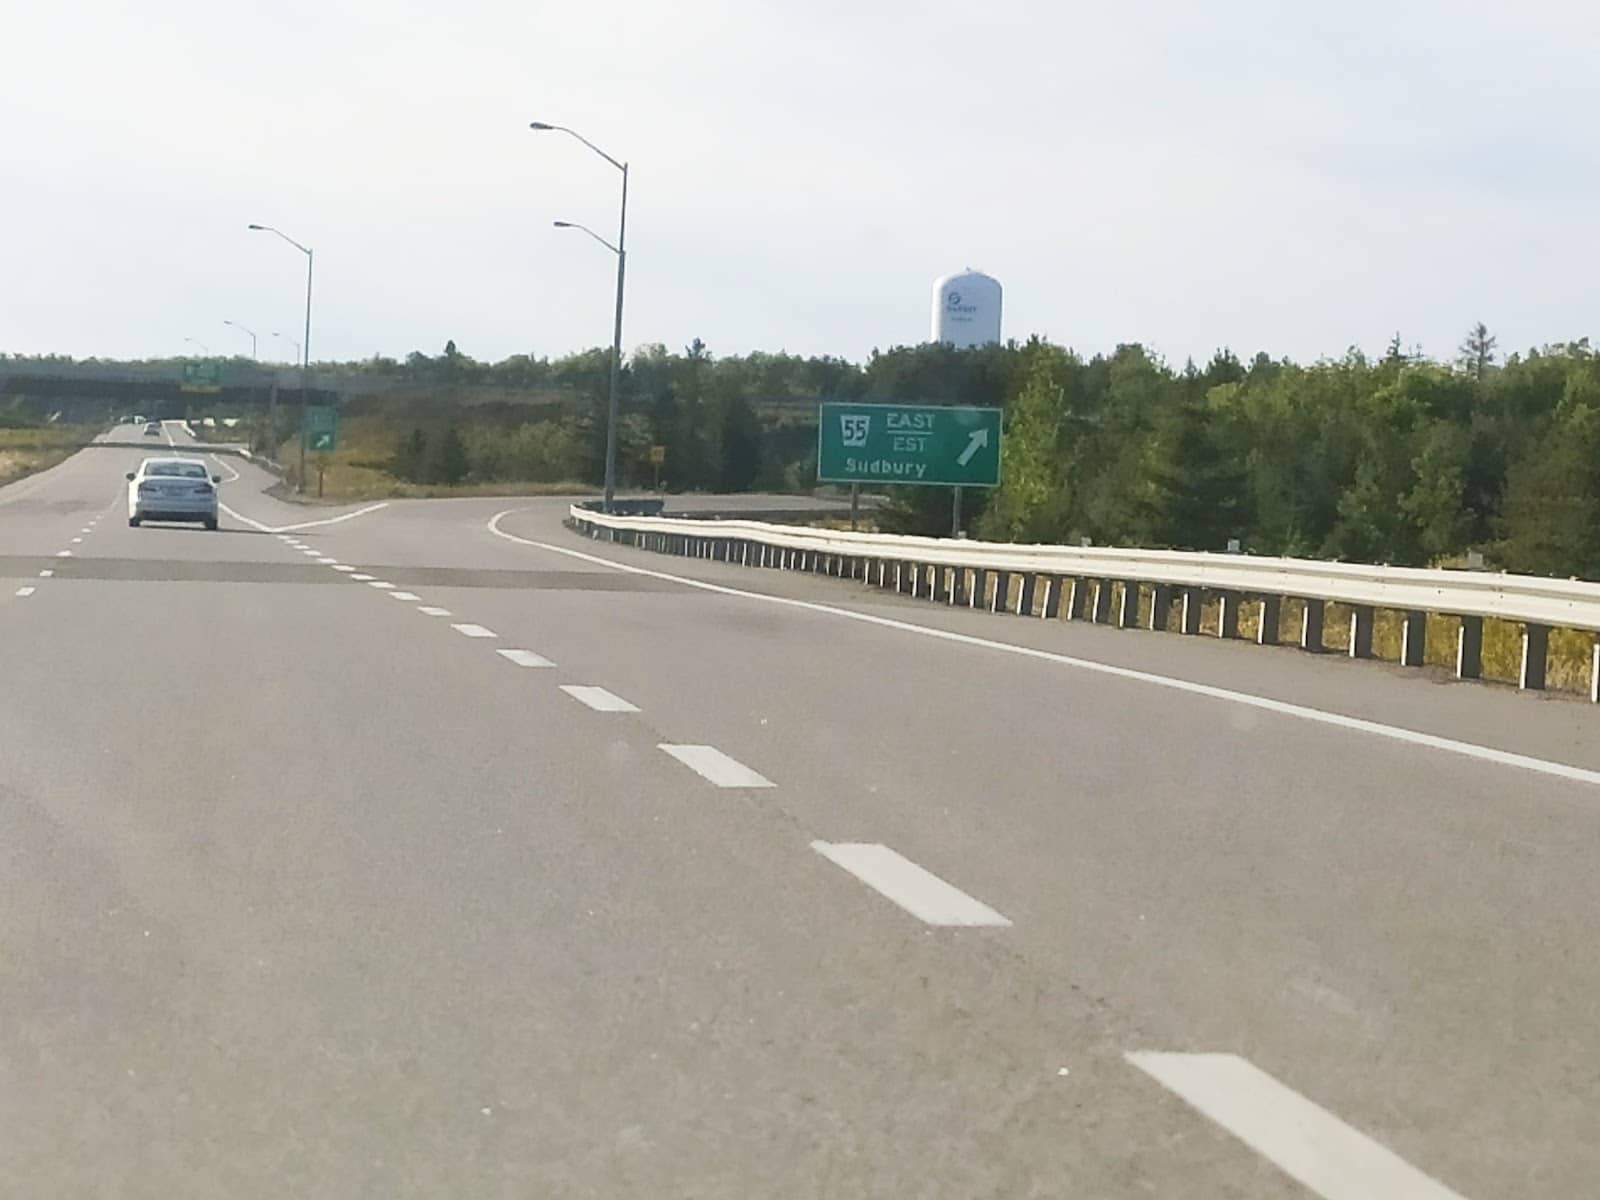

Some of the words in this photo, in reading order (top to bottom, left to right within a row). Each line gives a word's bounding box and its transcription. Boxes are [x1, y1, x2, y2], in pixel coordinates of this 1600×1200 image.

[844, 419, 866, 441] 55
[886, 412, 936, 429] EAST
[893, 436, 927, 452] EST
[845, 457, 927, 478] Sudbury
